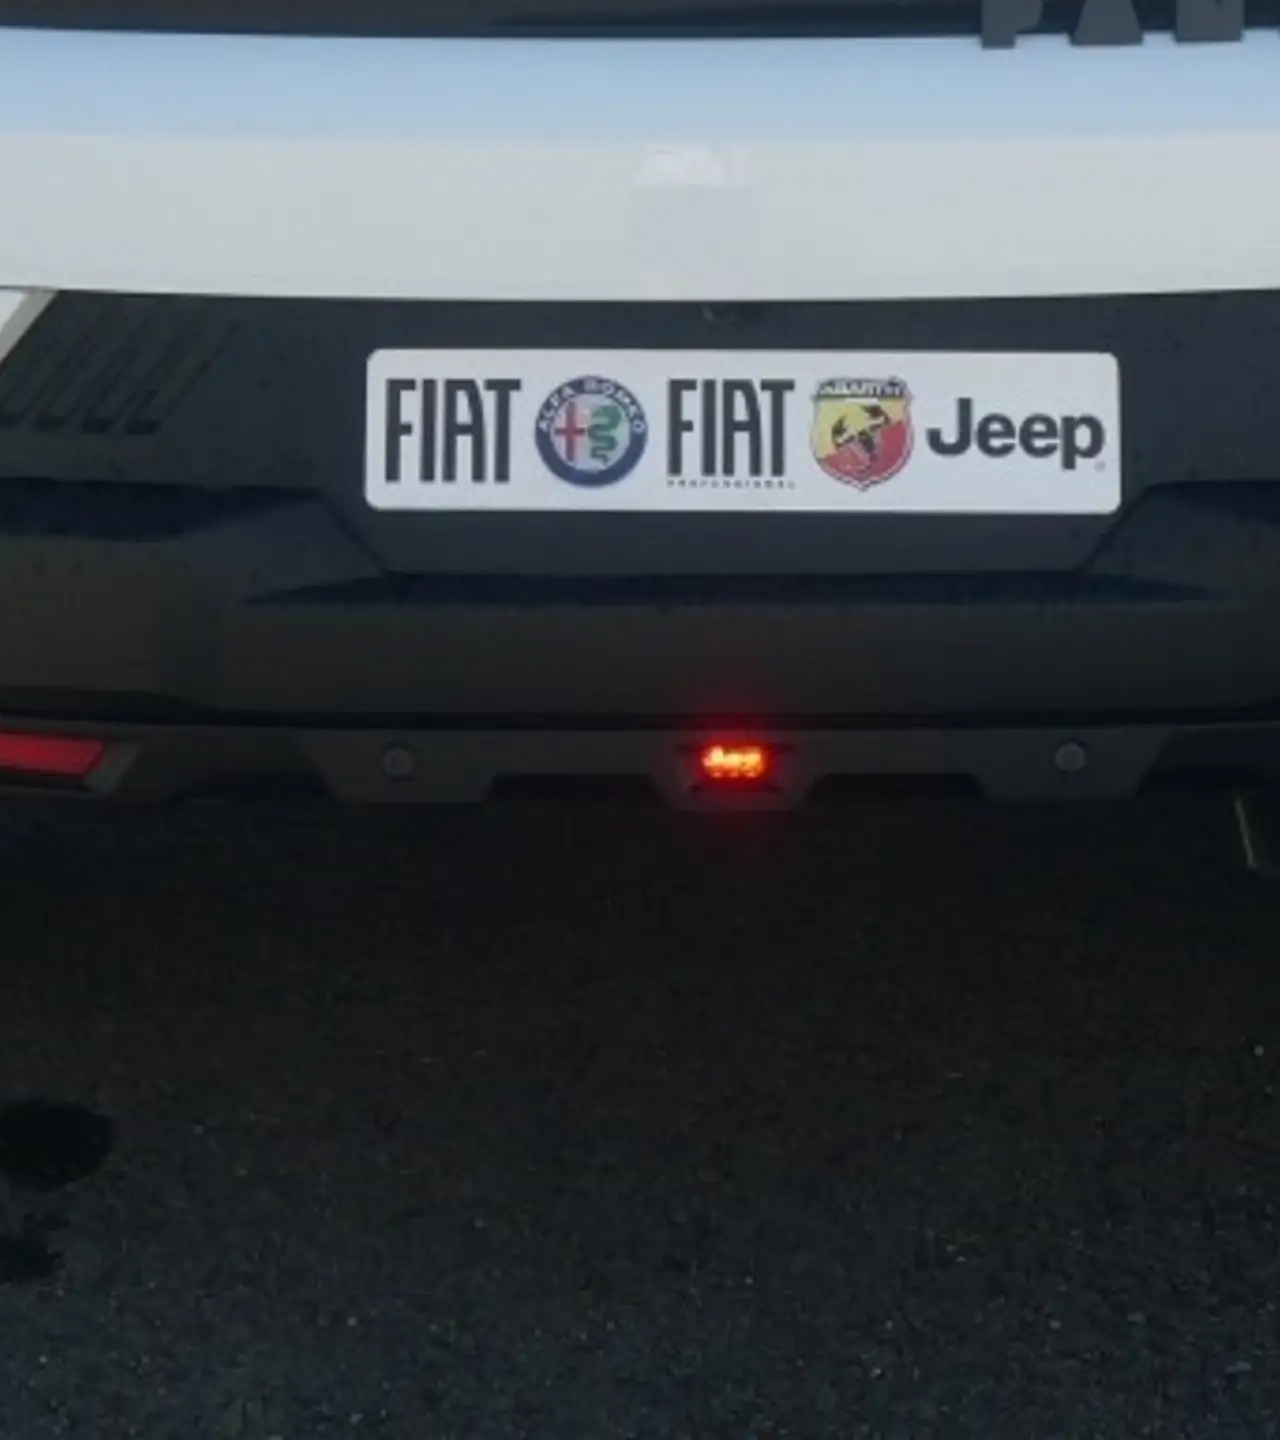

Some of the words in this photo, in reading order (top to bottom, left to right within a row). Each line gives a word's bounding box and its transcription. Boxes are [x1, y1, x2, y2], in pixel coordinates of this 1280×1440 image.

[385, 378, 521, 483] FIAT
[538, 383, 576, 432] ALFA
[583, 379, 647, 435] ROMEO
[667, 378, 795, 477] FIAT
[927, 397, 1105, 470] Jeep
